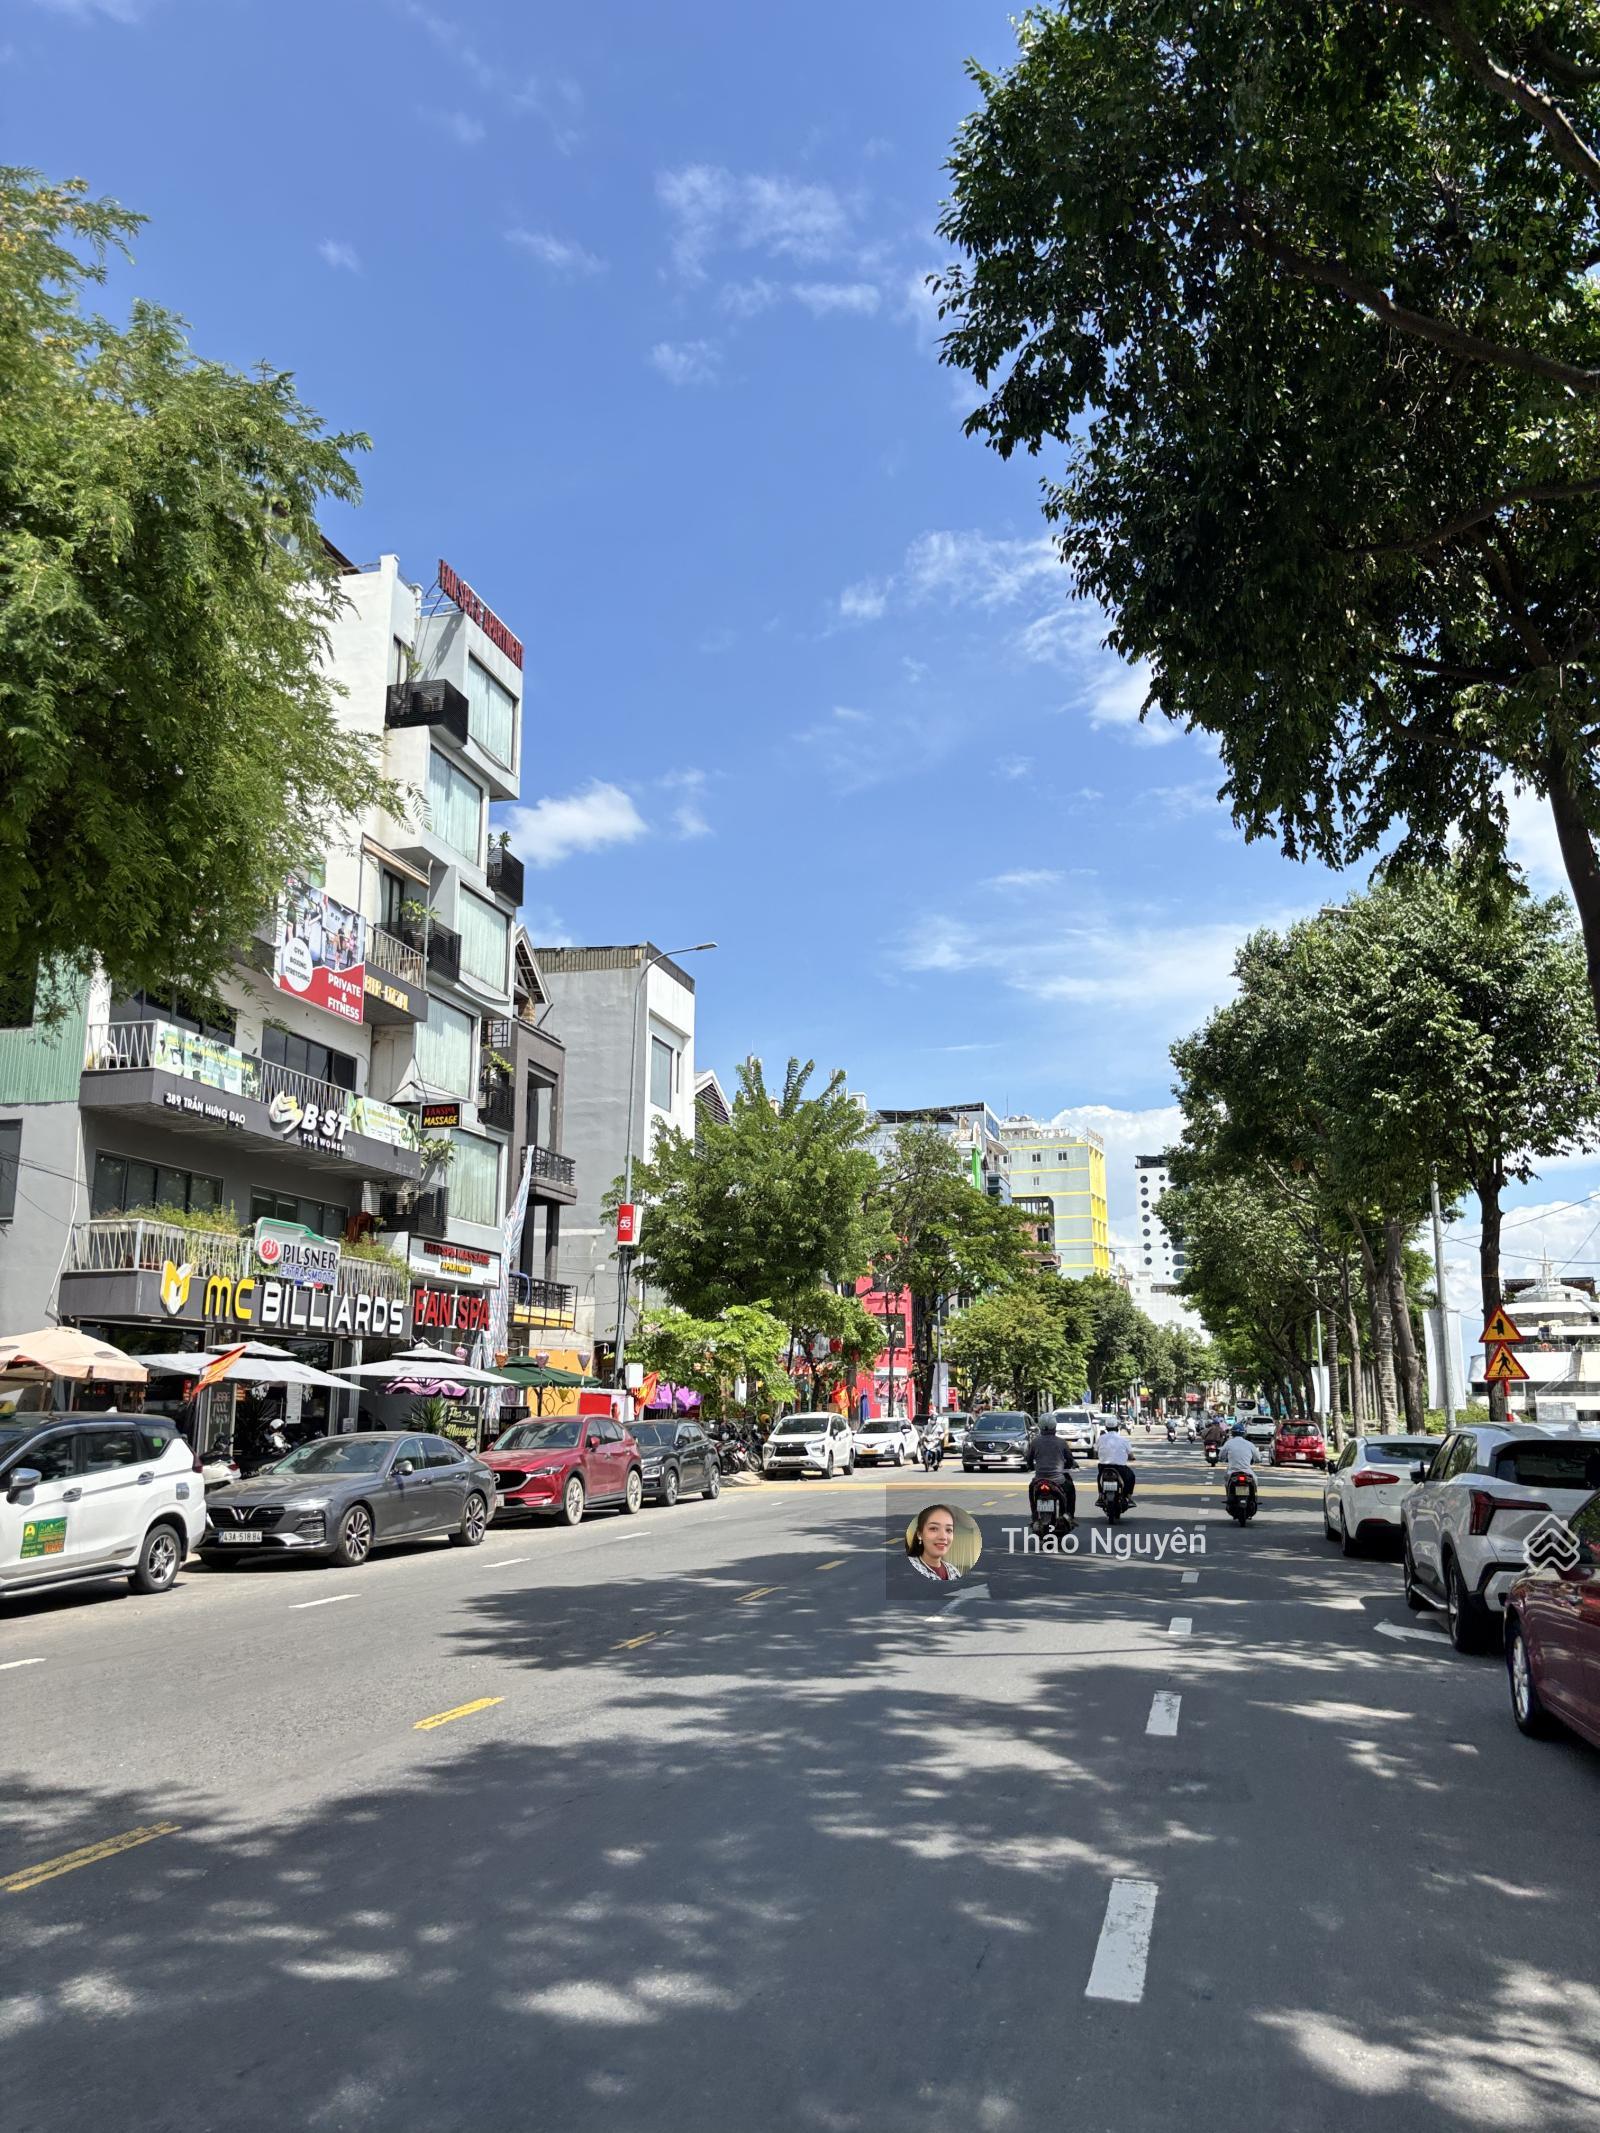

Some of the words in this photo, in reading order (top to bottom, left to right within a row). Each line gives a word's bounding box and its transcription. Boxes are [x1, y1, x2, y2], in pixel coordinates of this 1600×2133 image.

[481, 605, 523, 672] APARTMENT
[294, 946, 304, 957] GYM
[289, 956, 307, 970] BOXING
[285, 966, 310, 983] STRETCHING
[328, 973, 361, 998] PRIVATE
[341, 992, 348, 1003] &
[328, 997, 360, 1020] FITNESS
[166, 1092, 182, 1105] 389
[205, 1103, 228, 1118] HƯNG
[229, 1110, 246, 1127] ĐẠO
[424, 1115, 459, 1126] MASSAGE
[303, 1133, 318, 1144] FOR
[319, 1138, 346, 1152] WOMEN
[282, 1243, 337, 1270] PILSNER
[457, 1248, 491, 1265] MASSAGE
[280, 1263, 305, 1279] EXTRA
[306, 1269, 336, 1282] SMOOTH
[440, 1261, 472, 1274] APARTMENT
[262, 1281, 405, 1335] BILLIARDS
[415, 1289, 452, 1328] FAN
[457, 1295, 490, 1332] SPA
